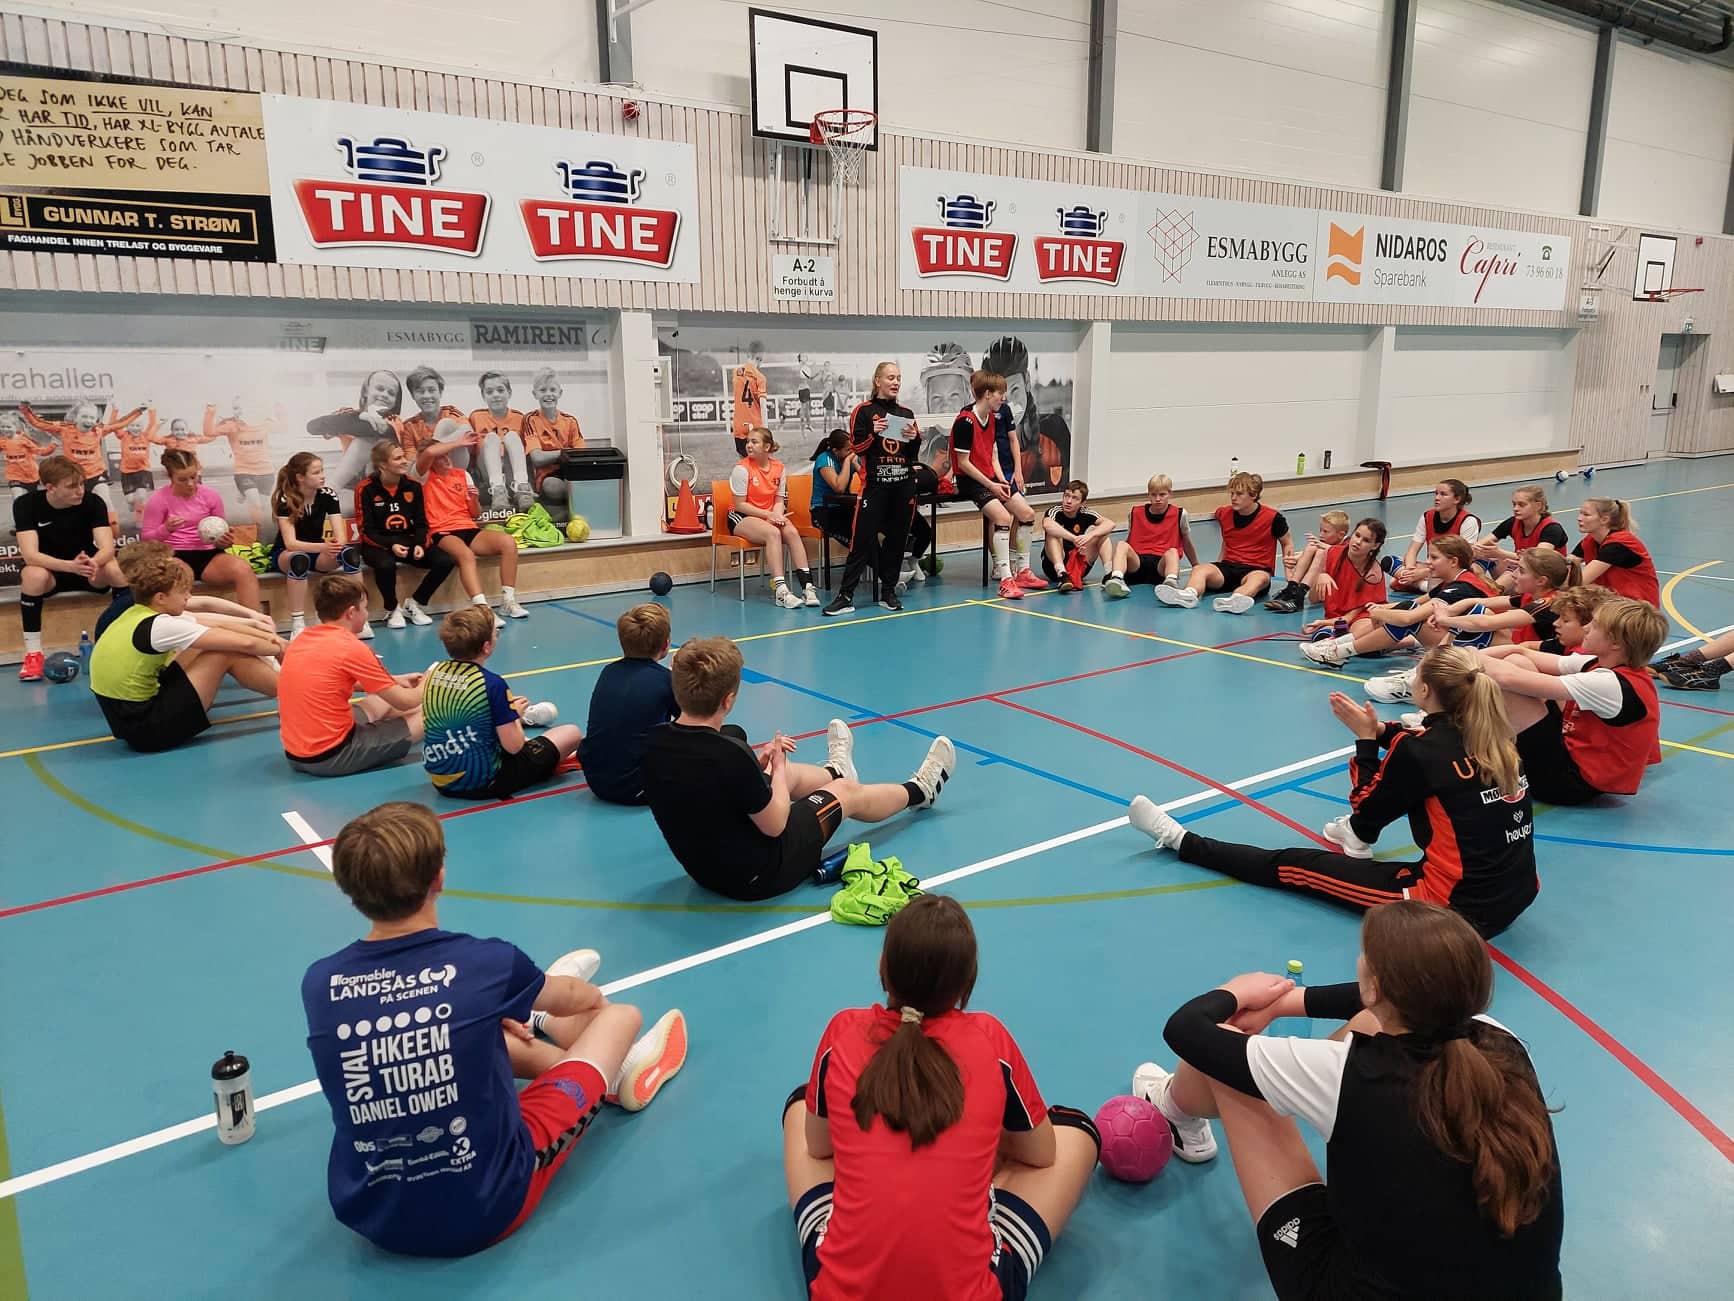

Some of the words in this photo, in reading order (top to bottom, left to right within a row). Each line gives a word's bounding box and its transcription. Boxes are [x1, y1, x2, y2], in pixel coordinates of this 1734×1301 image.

[40, 89, 76, 106] SOM
[88, 94, 128, 110] IKKE
[138, 98, 172, 118] VIL,
[180, 102, 213, 119] KAN
[18, 109, 56, 124] HAR
[60, 110, 97, 131] TID,
[102, 117, 134, 131] HAR
[138, 119, 205, 137] XL-BYGG
[210, 124, 265, 141] AVTALE
[11, 128, 146, 151] HÅNDVERKERE
[160, 138, 197, 152] SOM
[206, 140, 241, 156] TAR
[27, 153, 95, 170] JOBBEN
[104, 154, 147, 170] FOR
[155, 156, 198, 170] DEG.
[43, 206, 140, 228] GUNNAR
[144, 213, 164, 229] T.
[169, 214, 241, 234] STRØM
[315, 188, 466, 240] TINE
[7, 234, 71, 246] FAGHANDEL
[106, 240, 150, 250] TRELAST
[151, 242, 167, 251] OG
[168, 243, 224, 254] BYGGEVARE
[537, 208, 660, 253] TINE
[922, 234, 1004, 268] TINE
[1043, 243, 1114, 274] TINE
[1207, 236, 1309, 264] ESMABYGG
[1375, 232, 1448, 263] NIDAROS
[792, 258, 816, 273] A-2
[1373, 267, 1427, 289] Sparebank
[1460, 234, 1522, 305] Capri
[774, 285, 802, 298] henge
[809, 286, 834, 297] kurva
[782, 275, 818, 287] Forbudt
[473, 324, 584, 346] RAMIRENT
[741, 379, 754, 409] 4
[389, 503, 400, 513] 15
[1505, 823, 1533, 844] høyer
[330, 974, 417, 1002] LANDSÅS
[380, 995, 395, 1005] PÅ
[396, 985, 439, 1001] SCENEN
[371, 1023, 451, 1066] HKEEM
[340, 1041, 374, 1103] SVAL
[378, 1053, 455, 1095] TURAB
[349, 1097, 407, 1125] DANIEL
[407, 1082, 459, 1115] OWEN
